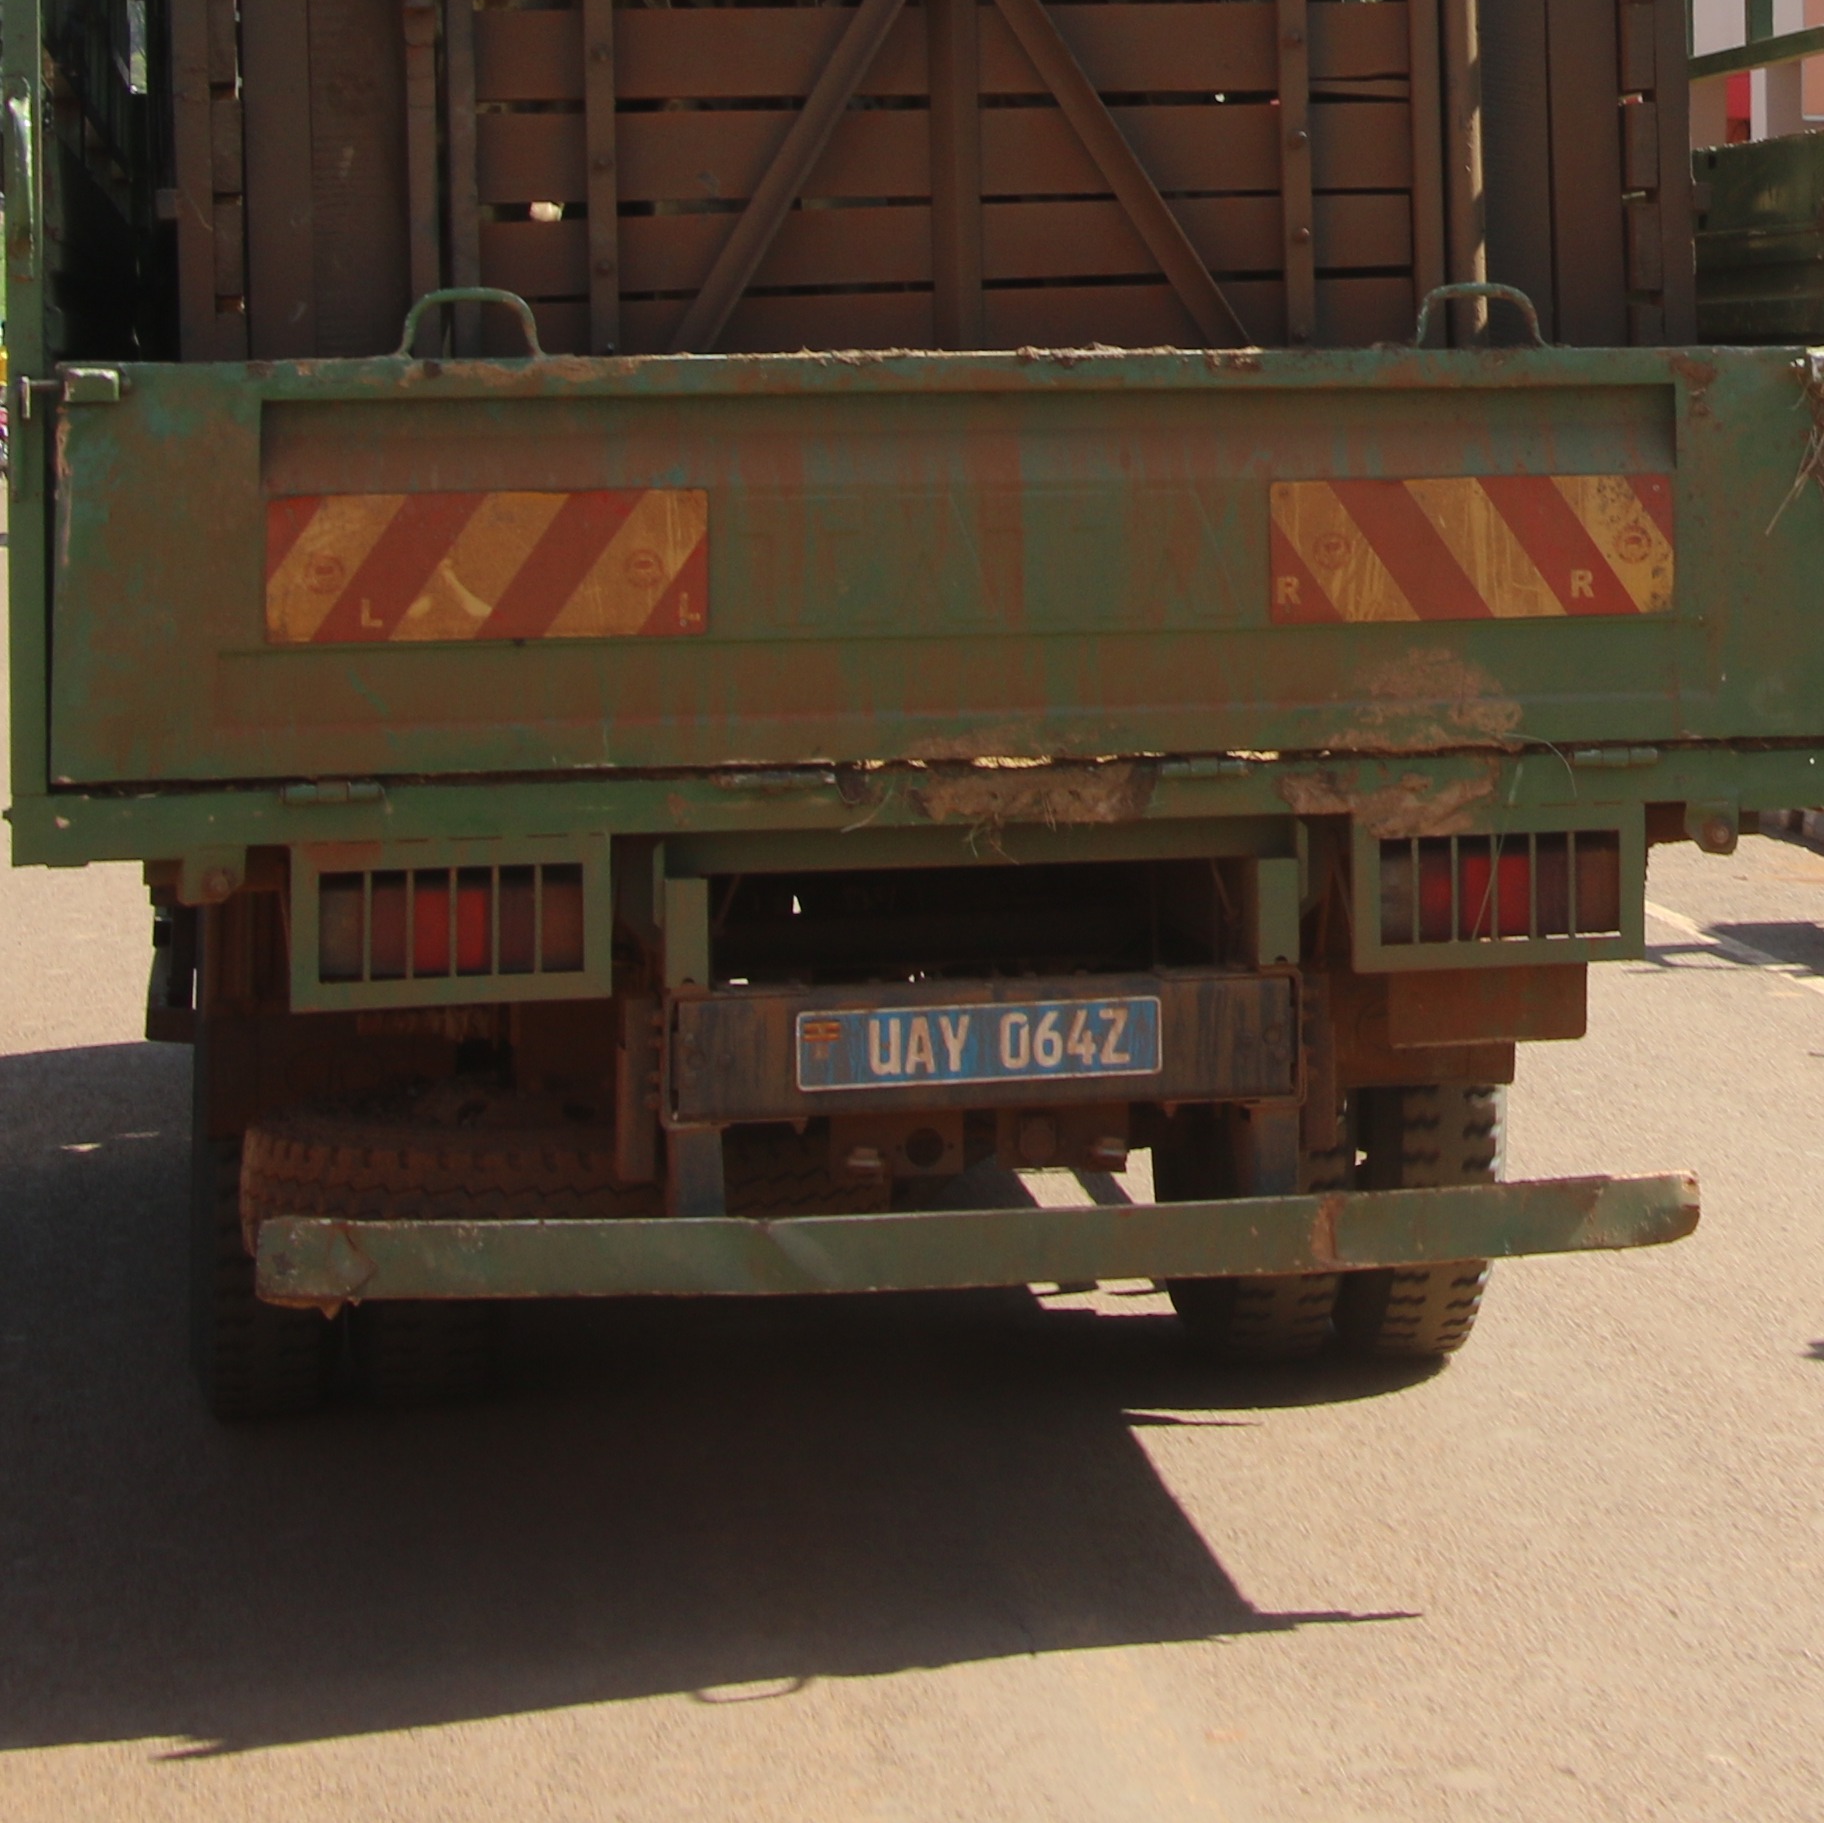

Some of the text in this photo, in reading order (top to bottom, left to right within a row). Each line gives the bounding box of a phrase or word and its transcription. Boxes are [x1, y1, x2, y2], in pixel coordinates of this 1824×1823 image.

[1276, 576, 1300, 605] R
[1570, 569, 1594, 598] R
[360, 599, 383, 627] L
[869, 1008, 1130, 1075] UAY 064Z
